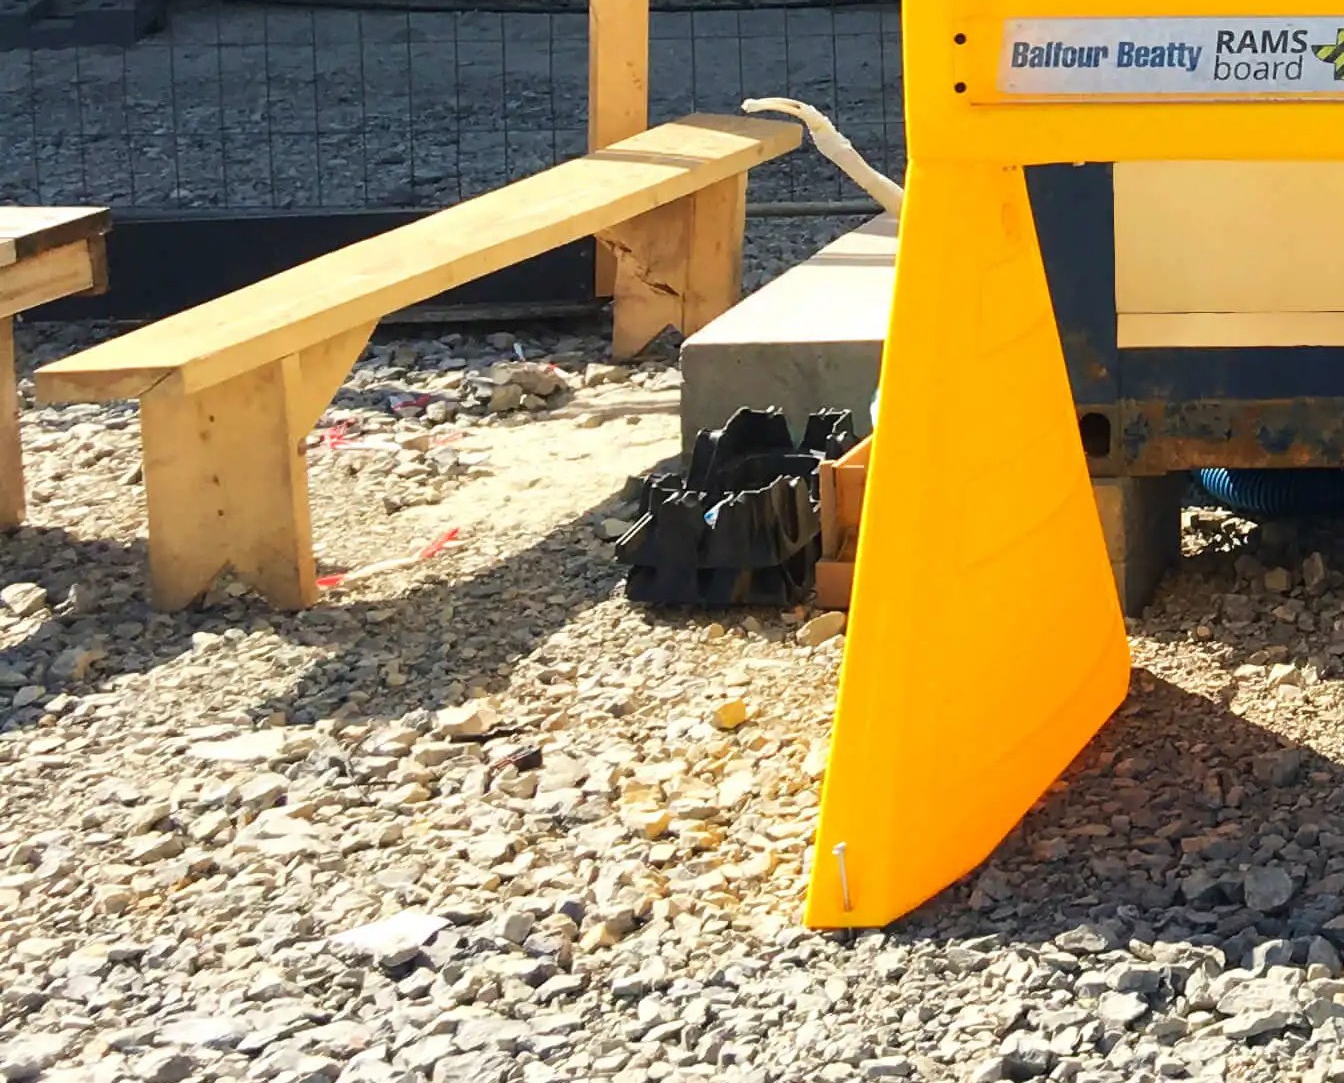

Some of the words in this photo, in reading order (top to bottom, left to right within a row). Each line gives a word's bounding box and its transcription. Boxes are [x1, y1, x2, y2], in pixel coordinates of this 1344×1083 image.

[1215, 29, 1308, 54] RAMS
[1011, 41, 1109, 68] Balfour
[1117, 41, 1202, 72] Beatty
[1213, 55, 1304, 81] board
